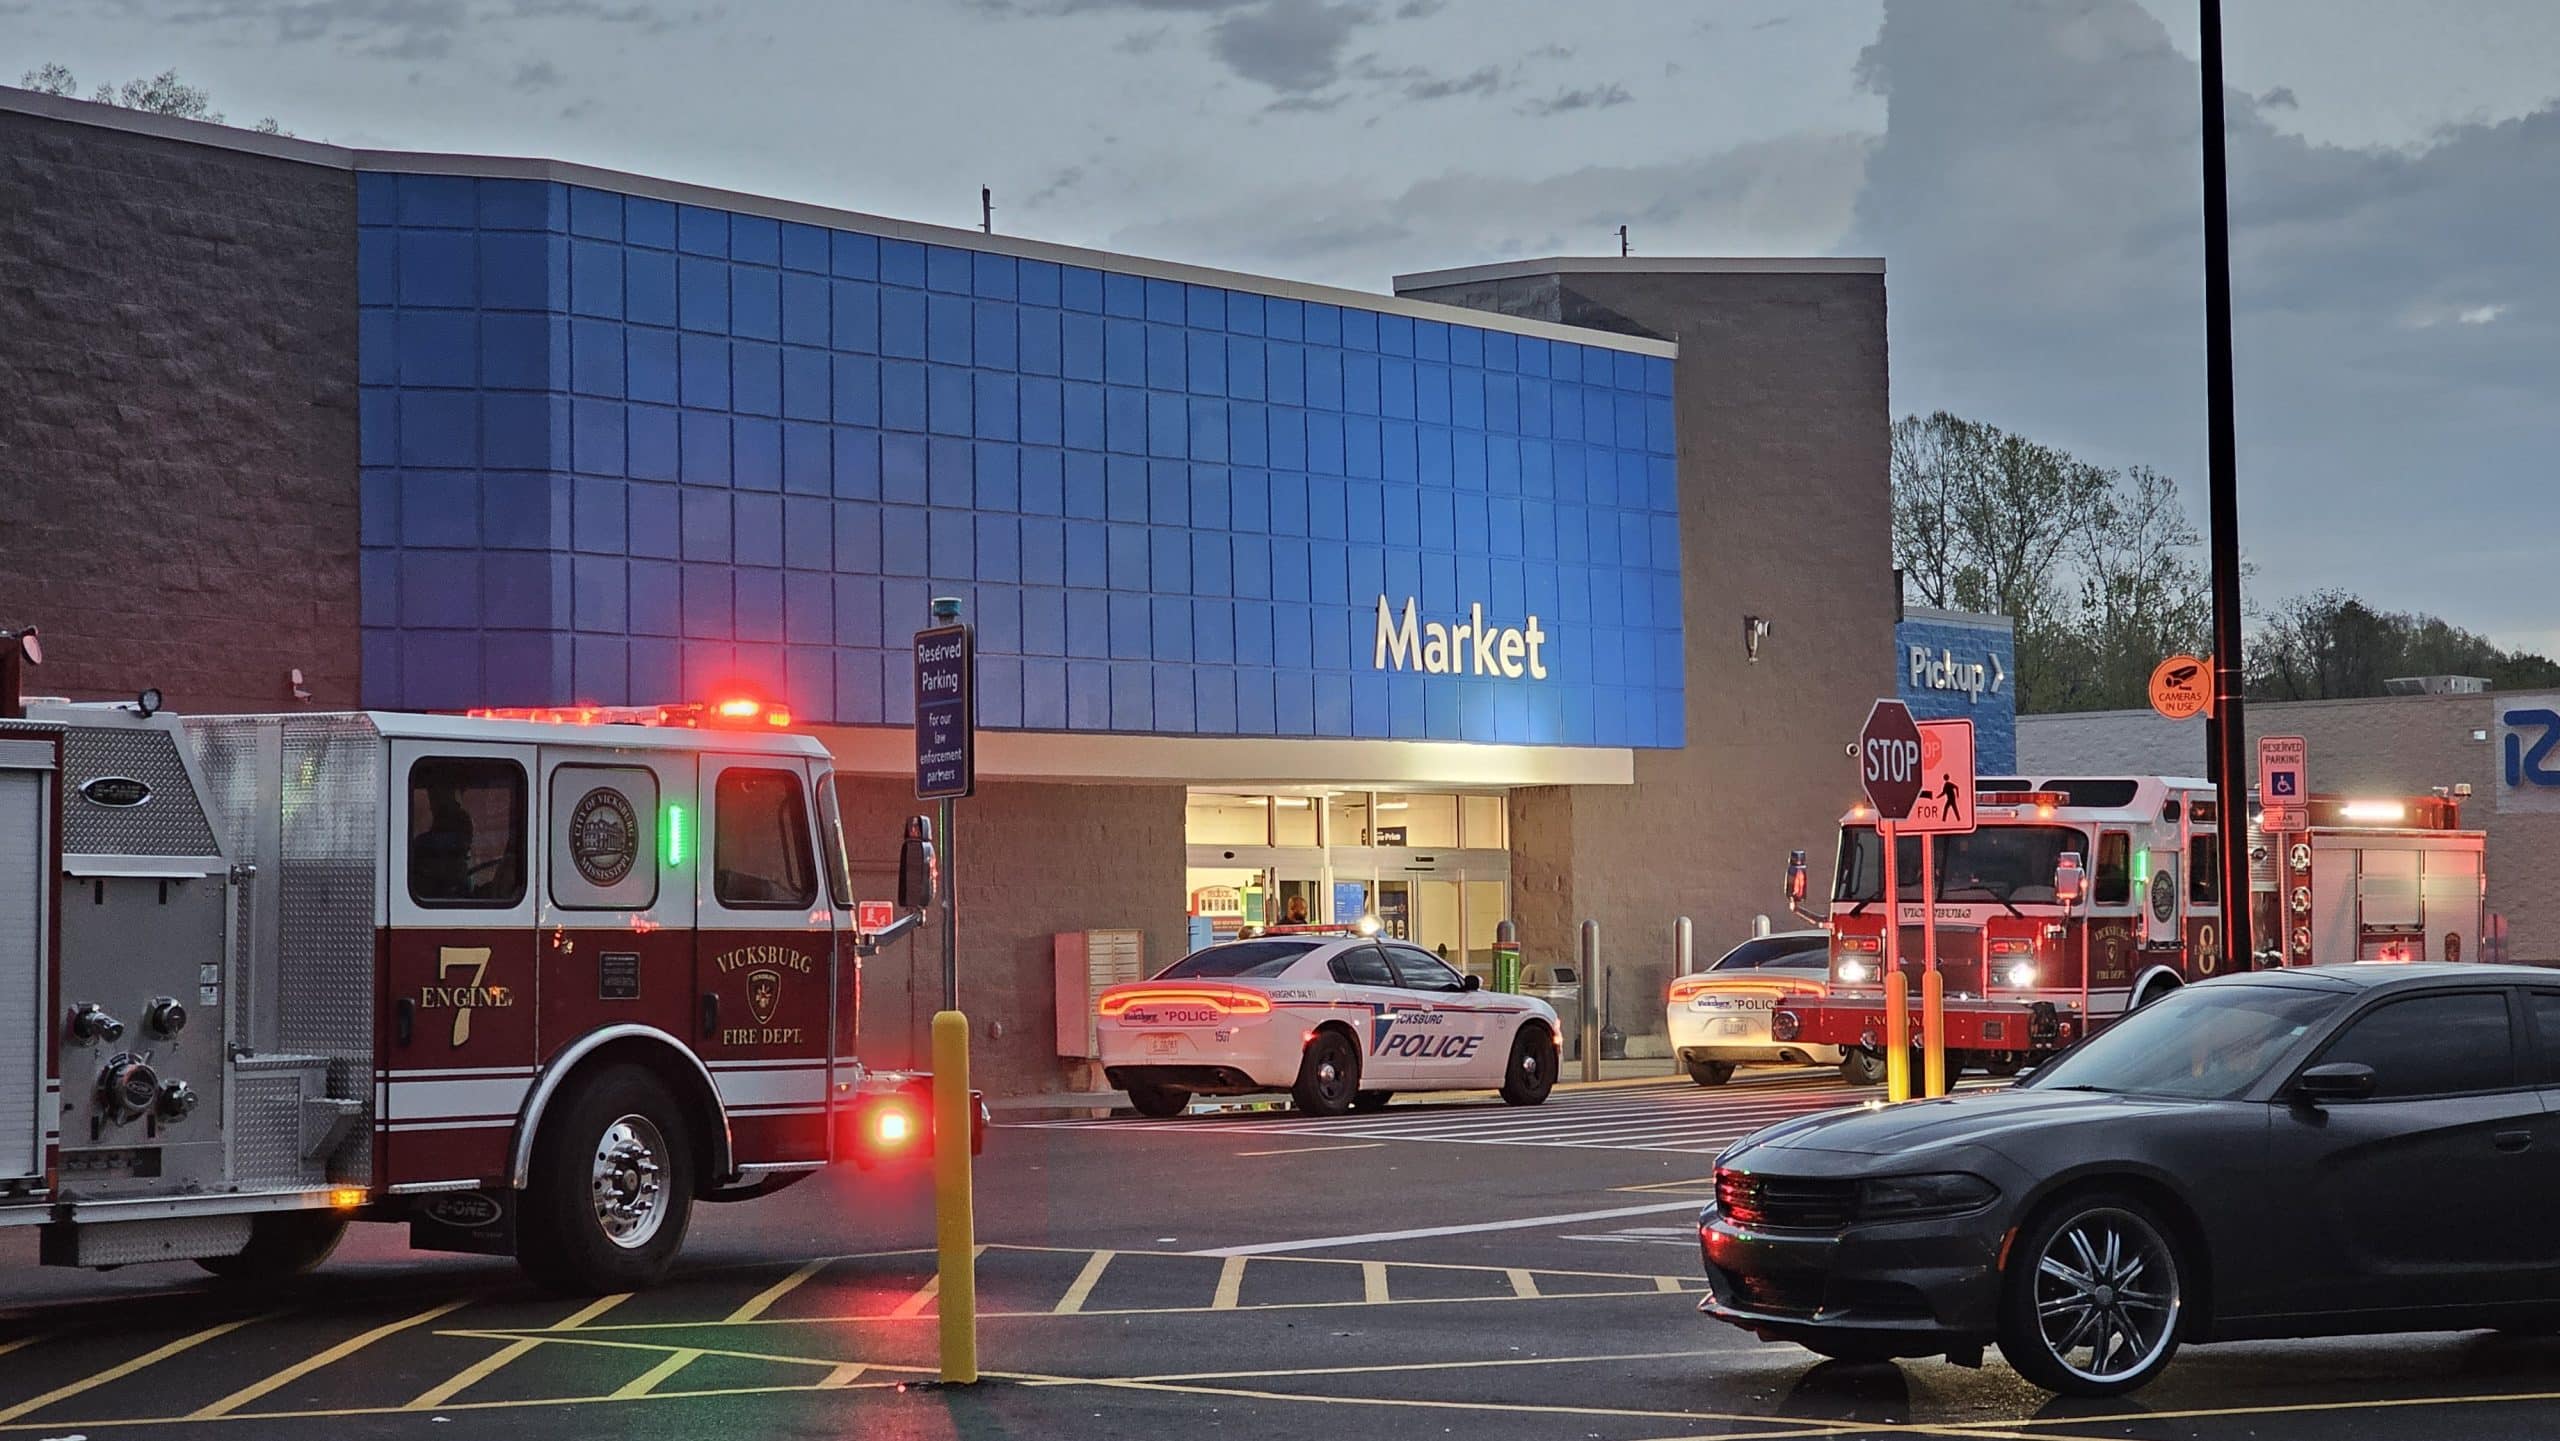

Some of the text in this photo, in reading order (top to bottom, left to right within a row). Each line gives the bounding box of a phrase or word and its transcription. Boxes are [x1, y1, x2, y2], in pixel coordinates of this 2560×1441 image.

[1375, 594, 1547, 680] Market
[918, 638, 962, 665] Reserved
[922, 670, 958, 693] Parking
[1909, 645, 1985, 704] Pickup
[2158, 692, 2202, 702] CAMERAS
[2165, 702, 2195, 711] IN USE
[940, 713, 952, 725] our
[934, 730, 947, 745] law
[920, 748, 962, 766] enforcement
[1923, 741, 1941, 757] OP
[2262, 742, 2303, 753] RESERVED
[1866, 738, 1919, 783] STOP
[2265, 754, 2301, 765] PARKING
[927, 769, 955, 785] partners
[597, 793, 636, 837] VICKSBURG
[1917, 806, 1938, 819] FOR
[581, 853, 631, 879] MISSISSIPPI
[1903, 907, 1971, 919] VICBURG
[2198, 924, 2215, 974] 8
[716, 945, 812, 974] VICKSBURG
[421, 986, 511, 1008] ENGINE
[439, 946, 492, 1047] 7
[1168, 1010, 1218, 1022] POLICE
[723, 1027, 803, 1046] FIRE DEPT.
[1380, 1033, 1485, 1058] POLICE
